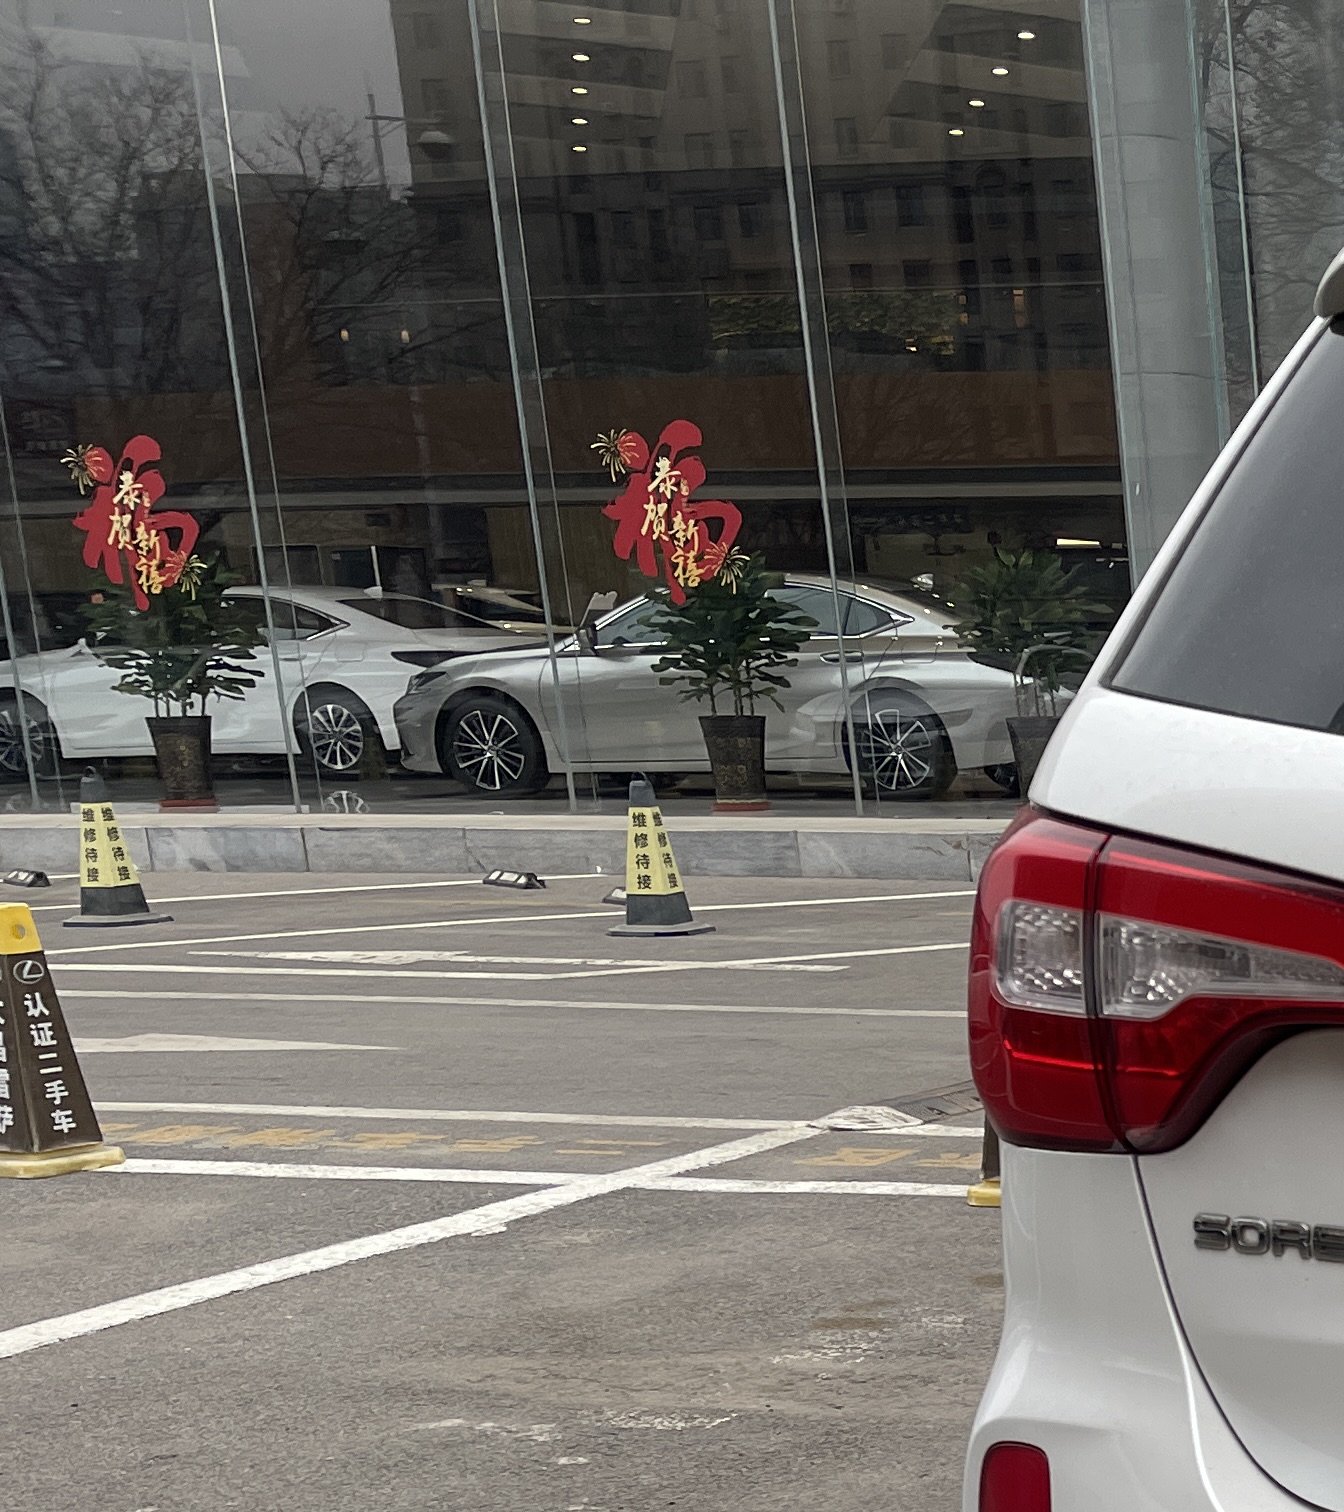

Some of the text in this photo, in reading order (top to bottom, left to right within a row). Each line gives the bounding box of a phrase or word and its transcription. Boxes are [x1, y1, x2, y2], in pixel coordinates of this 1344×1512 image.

[631, 811, 652, 890] 维修待接
[23, 991, 78, 1134] 认证二手车
